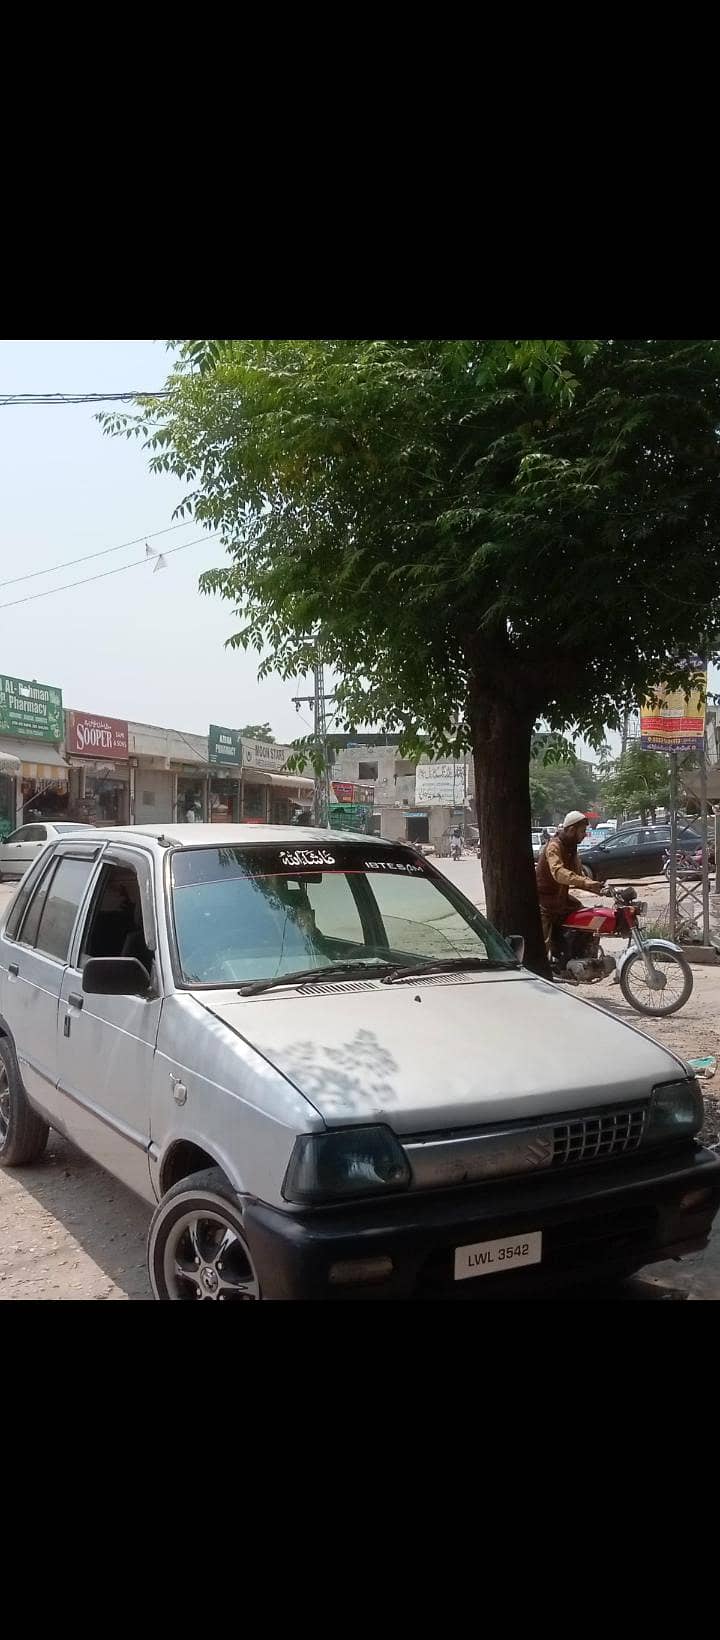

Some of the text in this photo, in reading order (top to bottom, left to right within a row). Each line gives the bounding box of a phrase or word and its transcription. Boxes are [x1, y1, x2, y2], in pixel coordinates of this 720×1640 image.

[9, 694, 47, 716] Pharmacy
[76, 723, 112, 750] SOOPER
[364, 861, 424, 874] IBTESAM
[467, 1243, 529, 1267] LWL 3542
